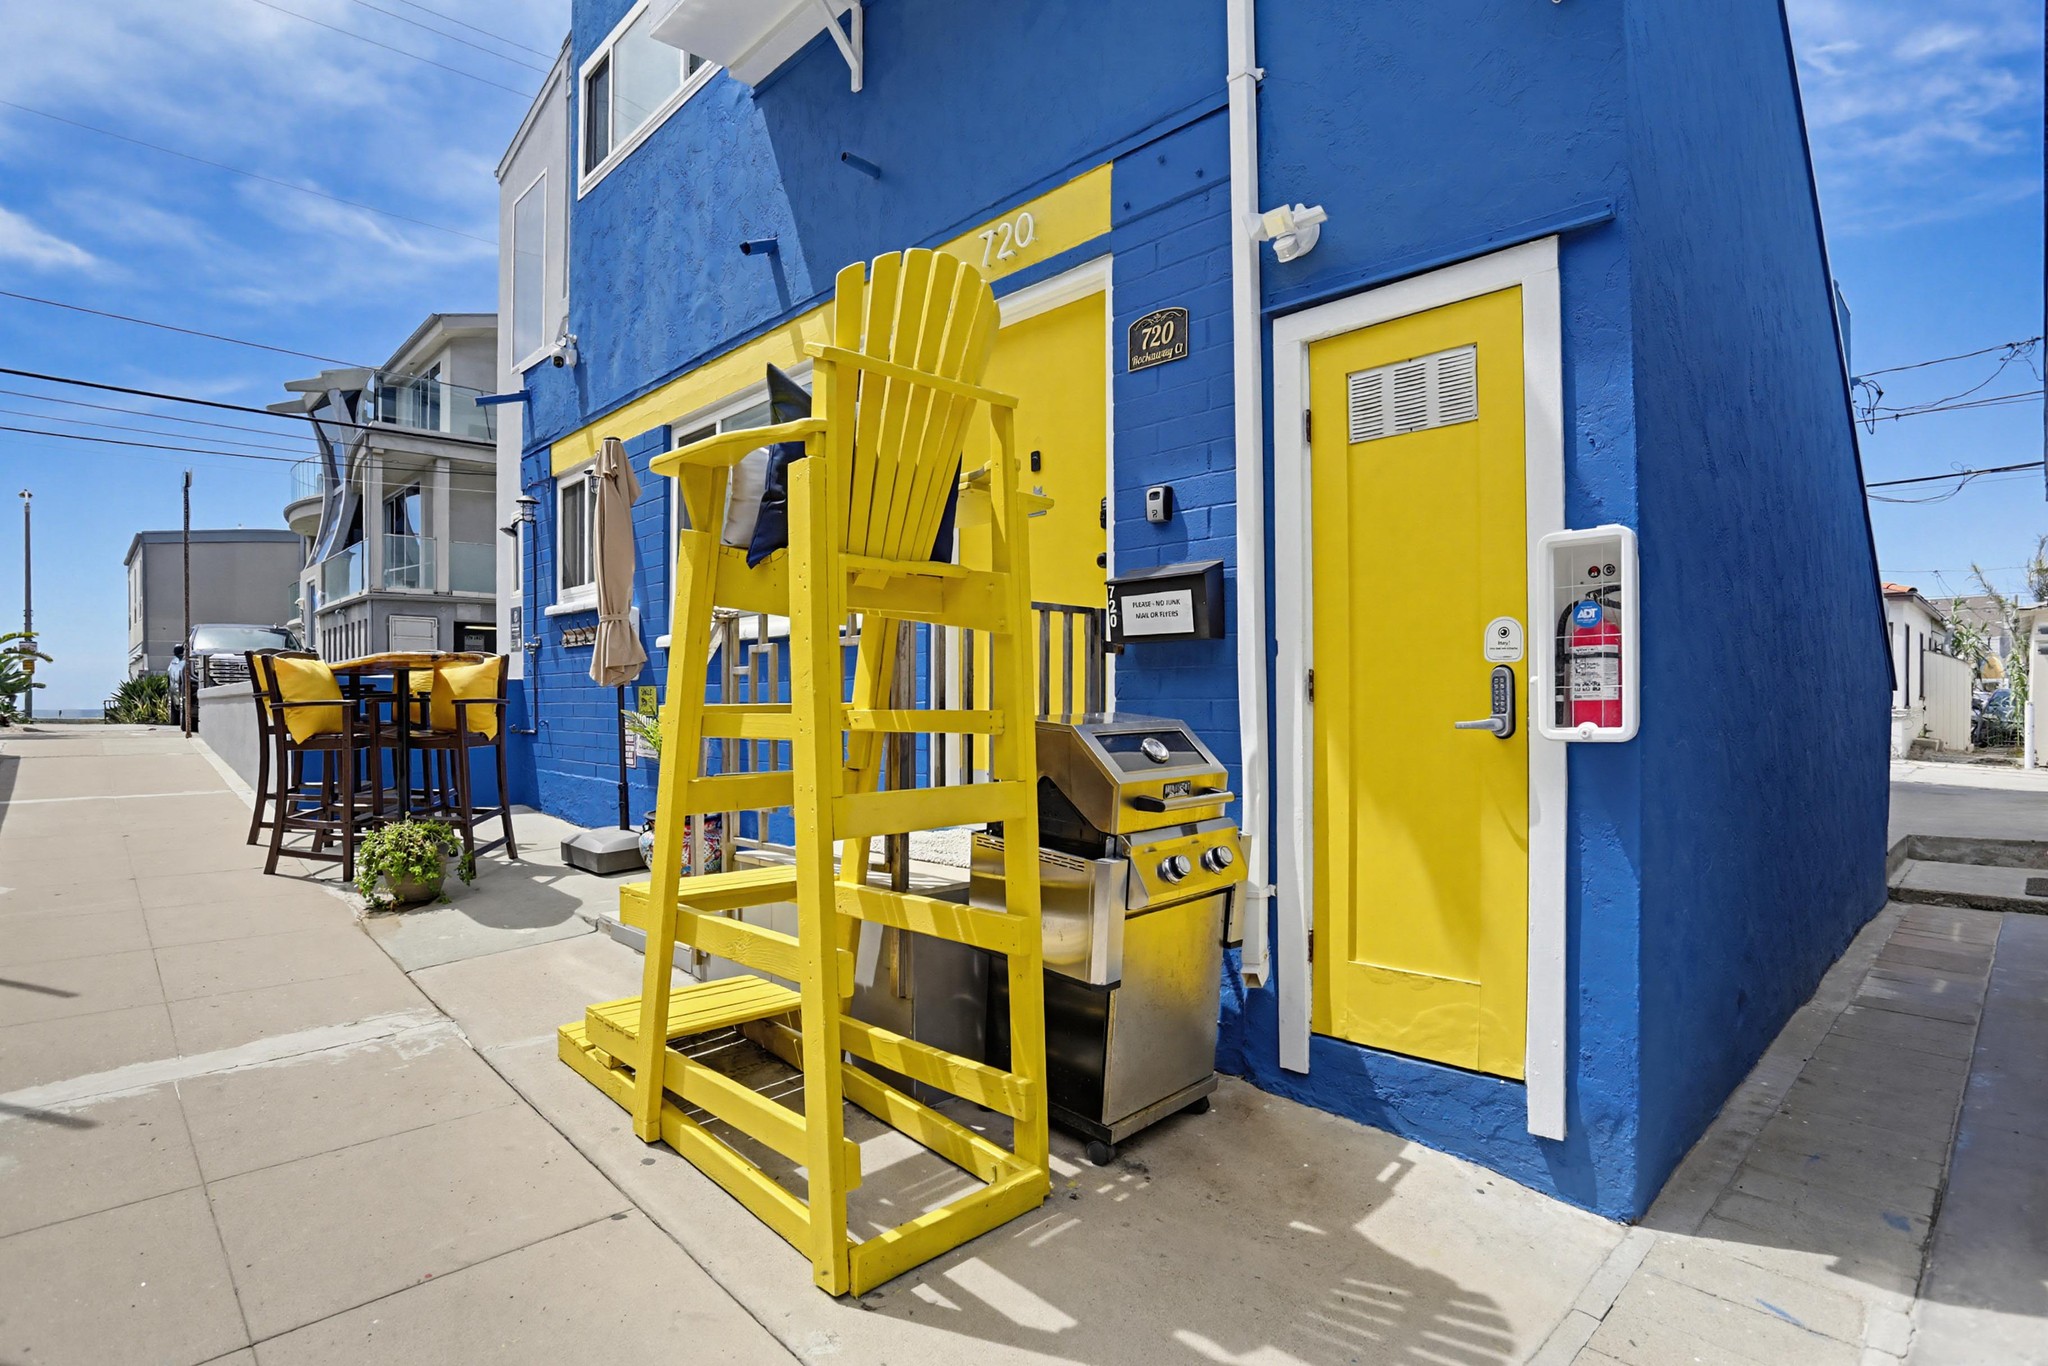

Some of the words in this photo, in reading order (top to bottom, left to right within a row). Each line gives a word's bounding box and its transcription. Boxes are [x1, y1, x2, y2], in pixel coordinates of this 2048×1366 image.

[978, 212, 1034, 268] 720
[1142, 320, 1174, 350] 720
[1108, 585, 1117, 628] 720
[1132, 600, 1151, 608] PLEASE
[1165, 598, 1181, 606] JUNK
[1159, 610, 1179, 618] FLYERS
[1577, 608, 1598, 619] ADT
